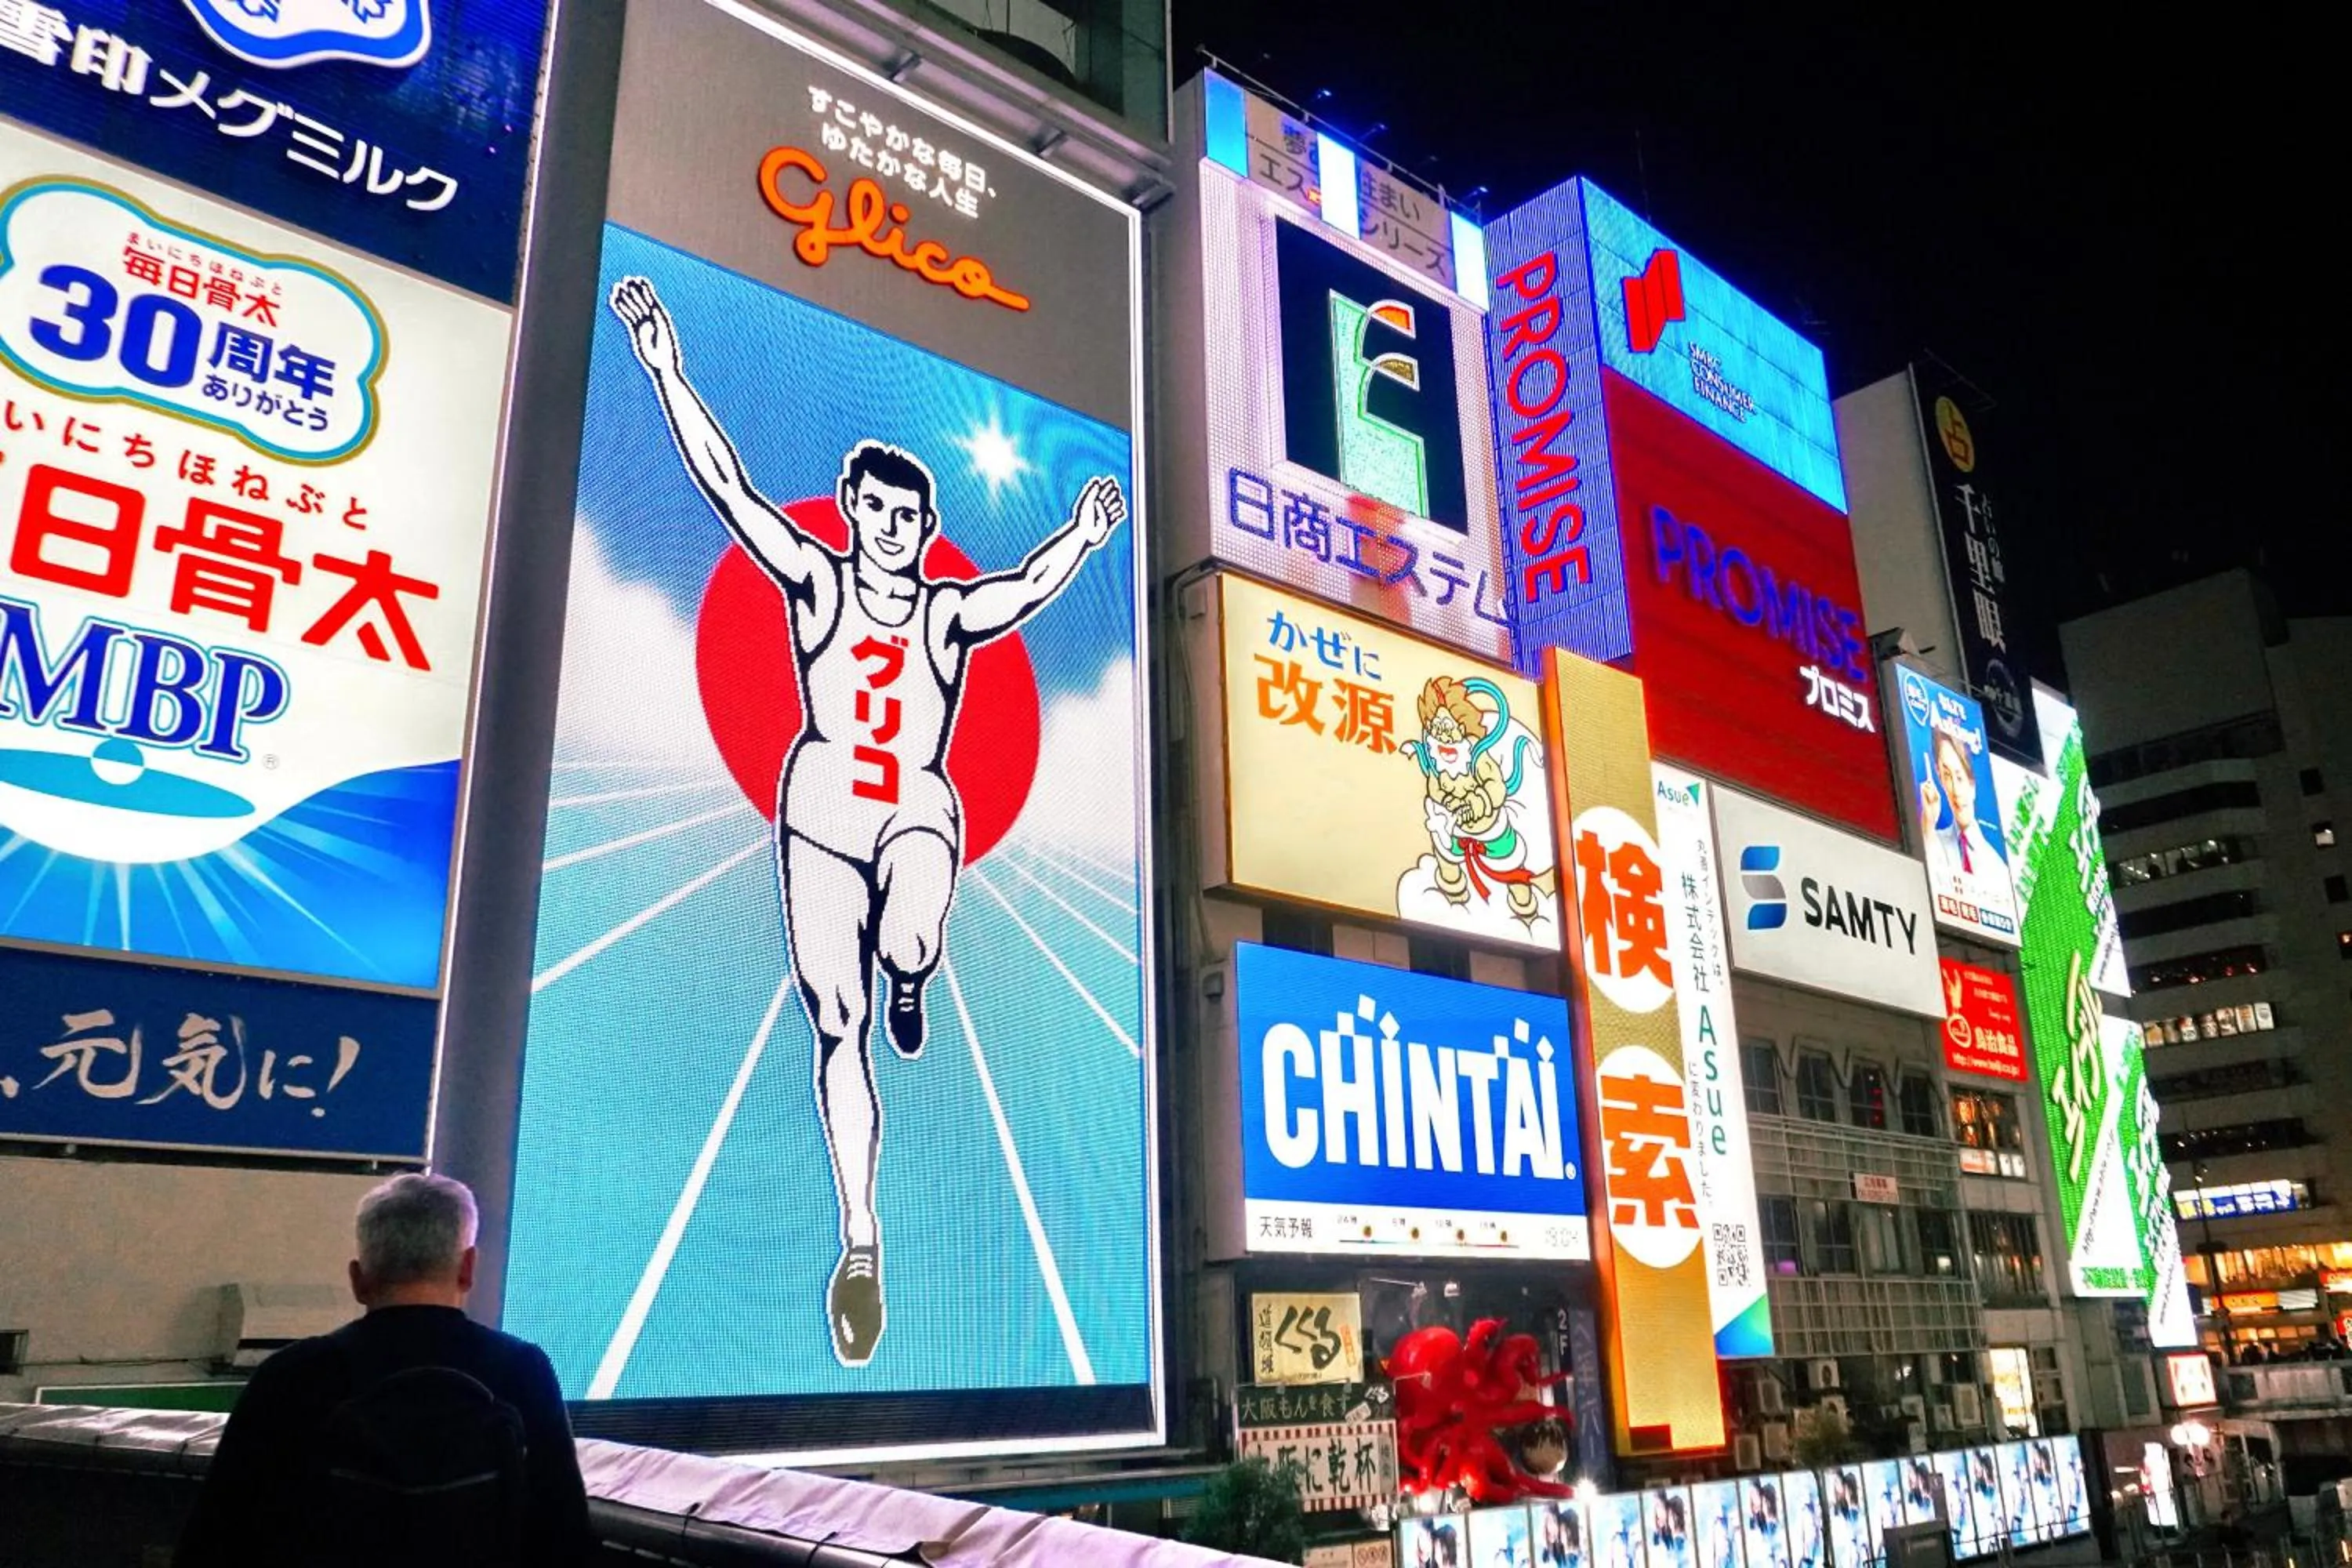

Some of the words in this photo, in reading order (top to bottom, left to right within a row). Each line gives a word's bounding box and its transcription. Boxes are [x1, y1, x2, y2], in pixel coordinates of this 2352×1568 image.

[0, 0, 458, 212] 雪印メグミルク
[821, 122, 979, 220] ゆたかな人生
[758, 145, 1030, 311] Glico
[122, 245, 281, 328] 毎日骨太
[201, 373, 329, 433] ありがとう
[1496, 250, 1594, 603] PROMISE
[0, 449, 440, 673] 日骨太
[1650, 504, 1868, 683] PROMISE
[0, 597, 290, 762] MBP
[1266, 609, 1383, 682] かぜに
[849, 633, 911, 805] グリコ
[1254, 652, 1399, 756] 改源
[1798, 665, 1876, 734] プロミス
[1656, 779, 1690, 806] Asue
[1800, 876, 1917, 956] SAMTY
[1261, 993, 1565, 1180] CHINTAI
[1258, 1214, 1314, 1240] 天気予報
[1275, 1305, 1342, 1370] くくる
